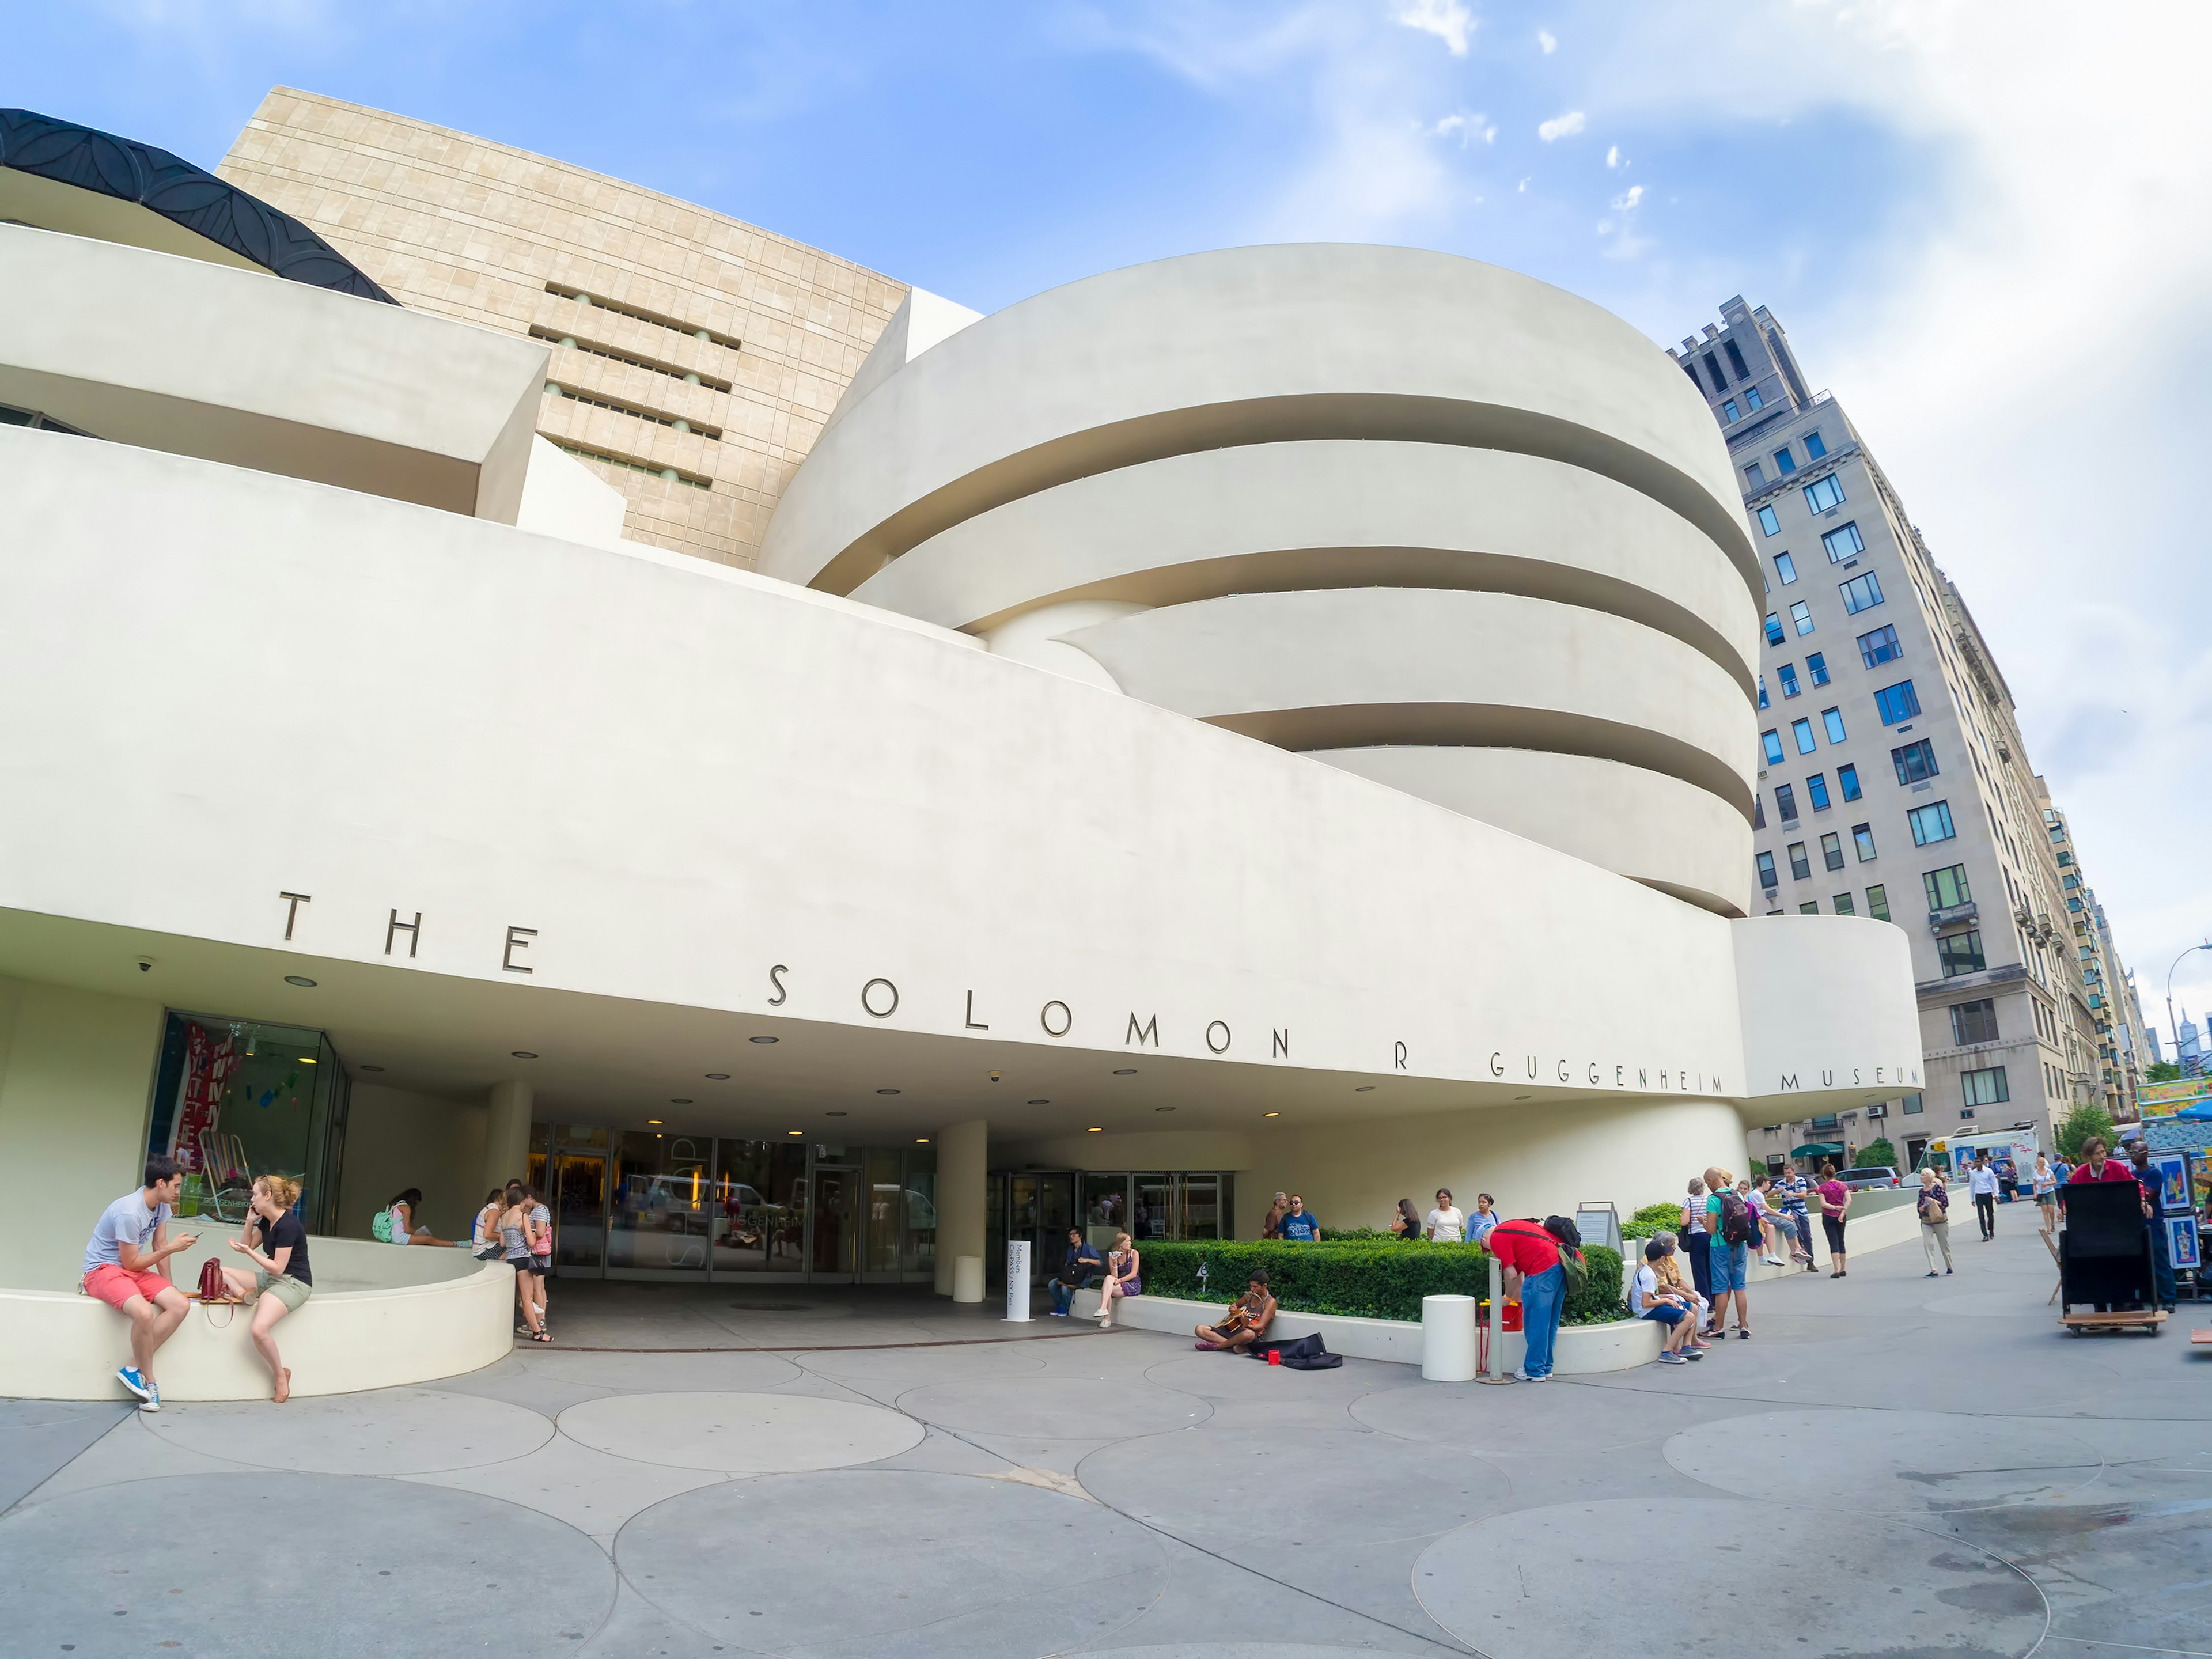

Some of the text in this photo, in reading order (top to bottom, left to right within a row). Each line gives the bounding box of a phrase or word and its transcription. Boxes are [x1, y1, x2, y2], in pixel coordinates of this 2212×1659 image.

[279, 891, 1918, 1093] THE SOLOMON R GUGGENHEIM MUSEUM
[719, 1214, 805, 1228] UGGENHEIM
[1009, 1280, 1014, 1291] NY
